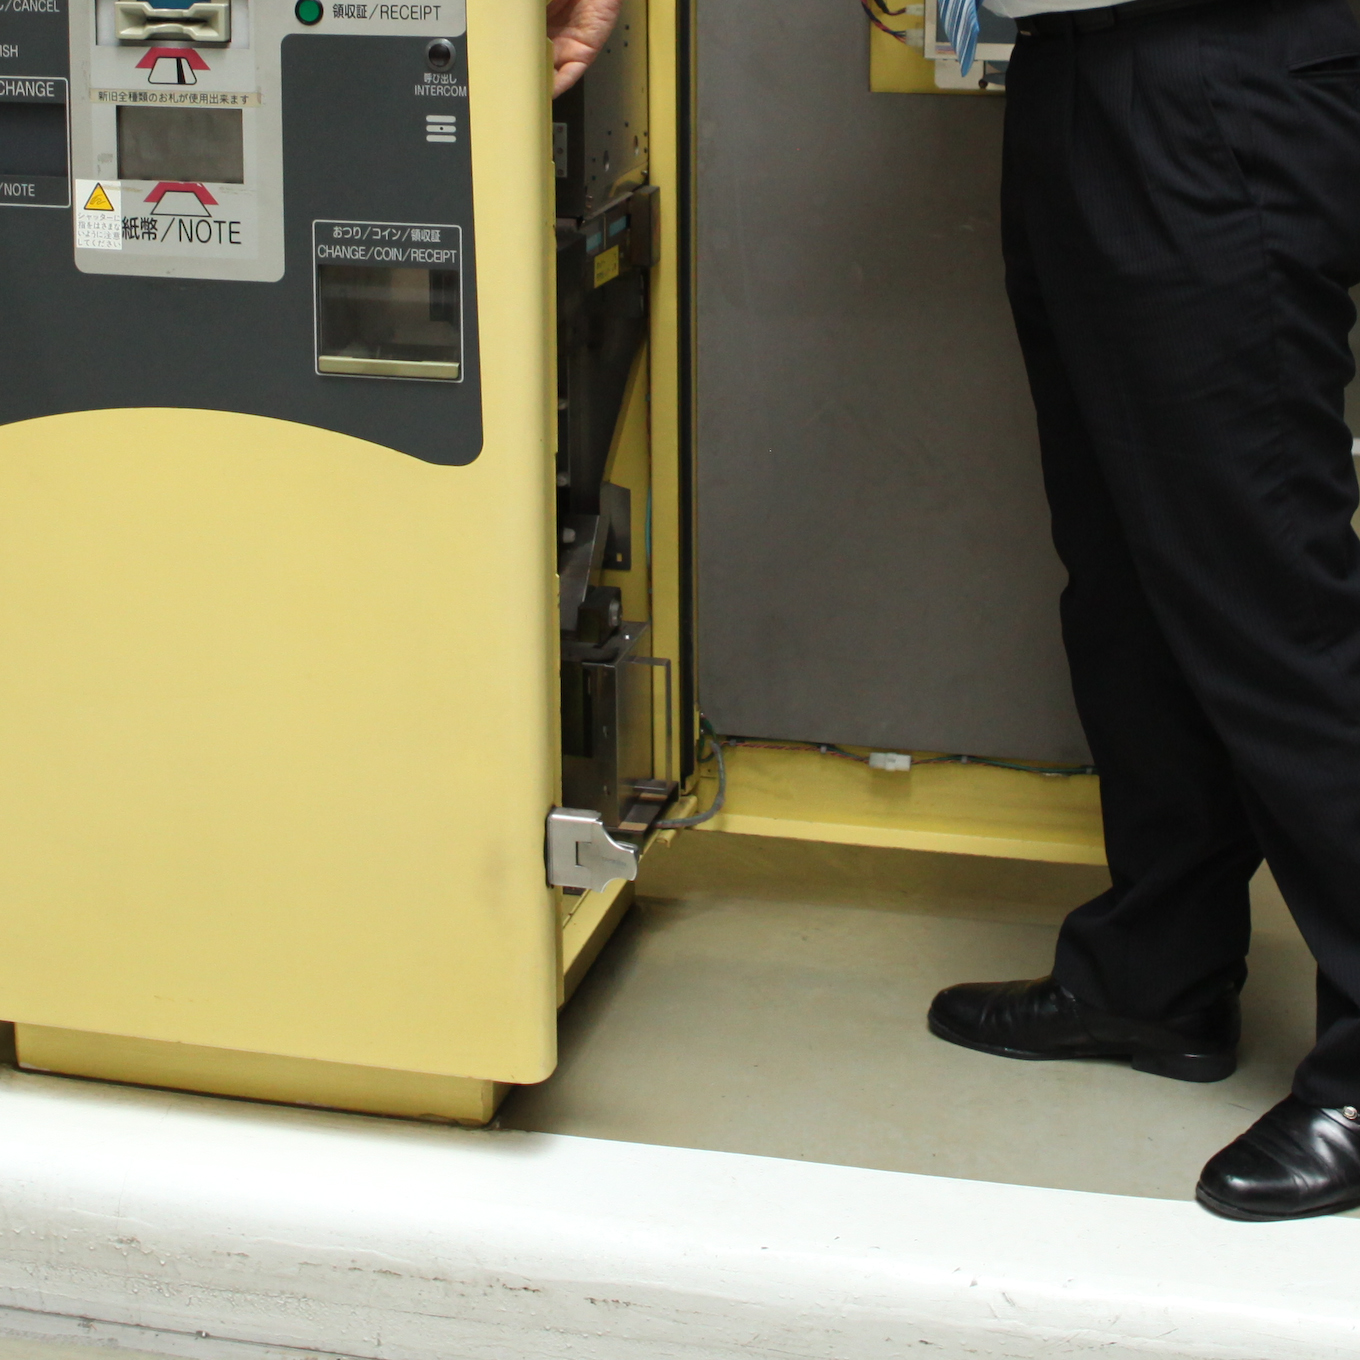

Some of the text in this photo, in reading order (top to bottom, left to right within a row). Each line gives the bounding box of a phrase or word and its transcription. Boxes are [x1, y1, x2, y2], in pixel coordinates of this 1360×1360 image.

[423, 72, 457, 84] 呼び出し
[414, 84, 467, 97] INTERCOM
[98, 91, 249, 105] 新旧全種類のお札が使用出来ます
